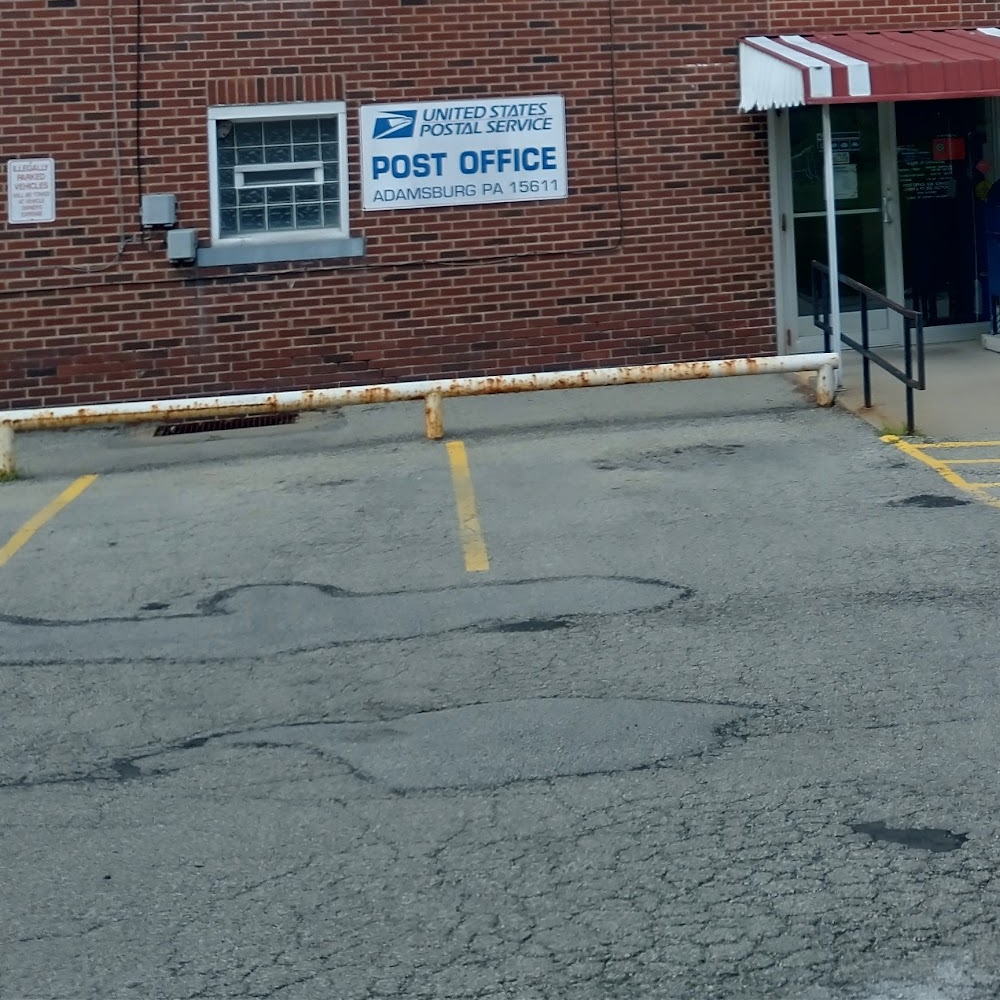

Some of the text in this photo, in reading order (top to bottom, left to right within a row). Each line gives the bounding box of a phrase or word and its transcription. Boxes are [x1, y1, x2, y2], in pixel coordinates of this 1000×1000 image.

[422, 103, 548, 122] UNITED STATES
[420, 117, 553, 137] POSTAL SERVICE
[12, 164, 48, 172] ILLEGALLY
[372, 147, 557, 180] POST OFFICE
[15, 182, 48, 190] VEHICLES
[373, 179, 558, 203] ADAMSBURG PA 15611
